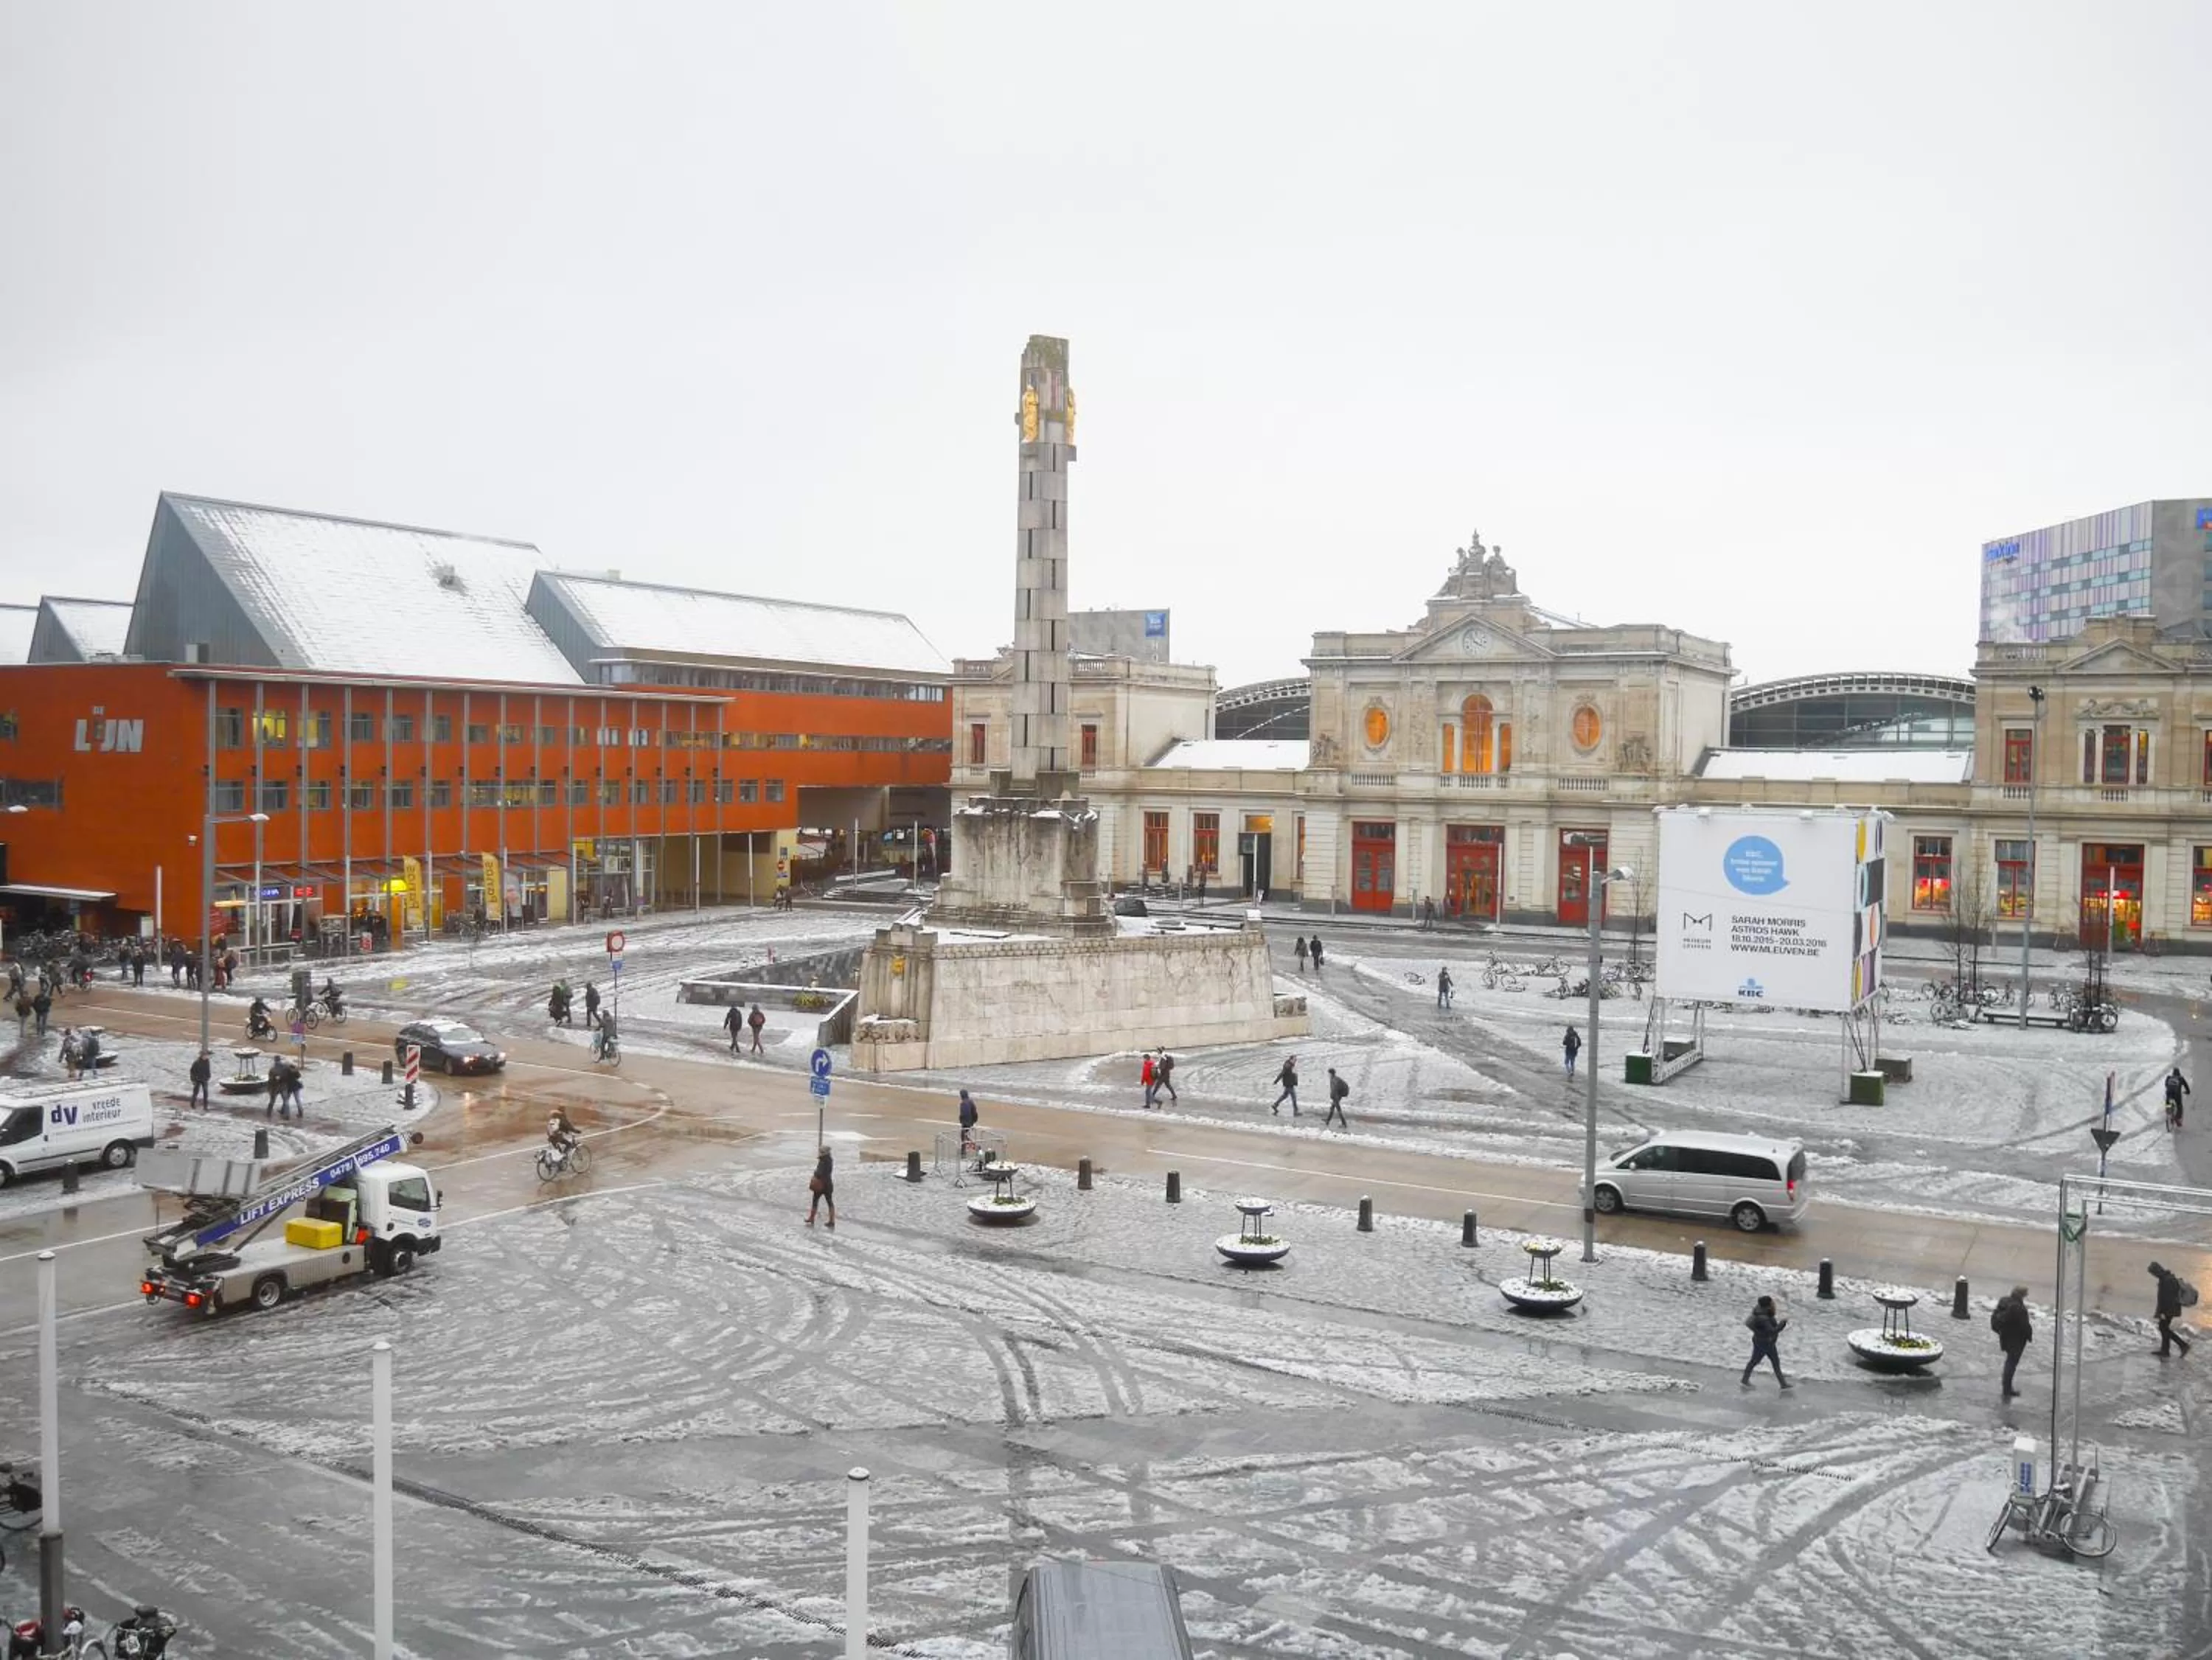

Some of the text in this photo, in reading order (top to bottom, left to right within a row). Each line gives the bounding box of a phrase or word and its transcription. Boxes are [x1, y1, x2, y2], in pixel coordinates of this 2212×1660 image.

[1731, 915, 1806, 928] SARAH MORRIS
[1770, 927, 1799, 936] HAWK
[240, 1203, 265, 1224] LIFT
[268, 1177, 319, 1210] EXPRESS
